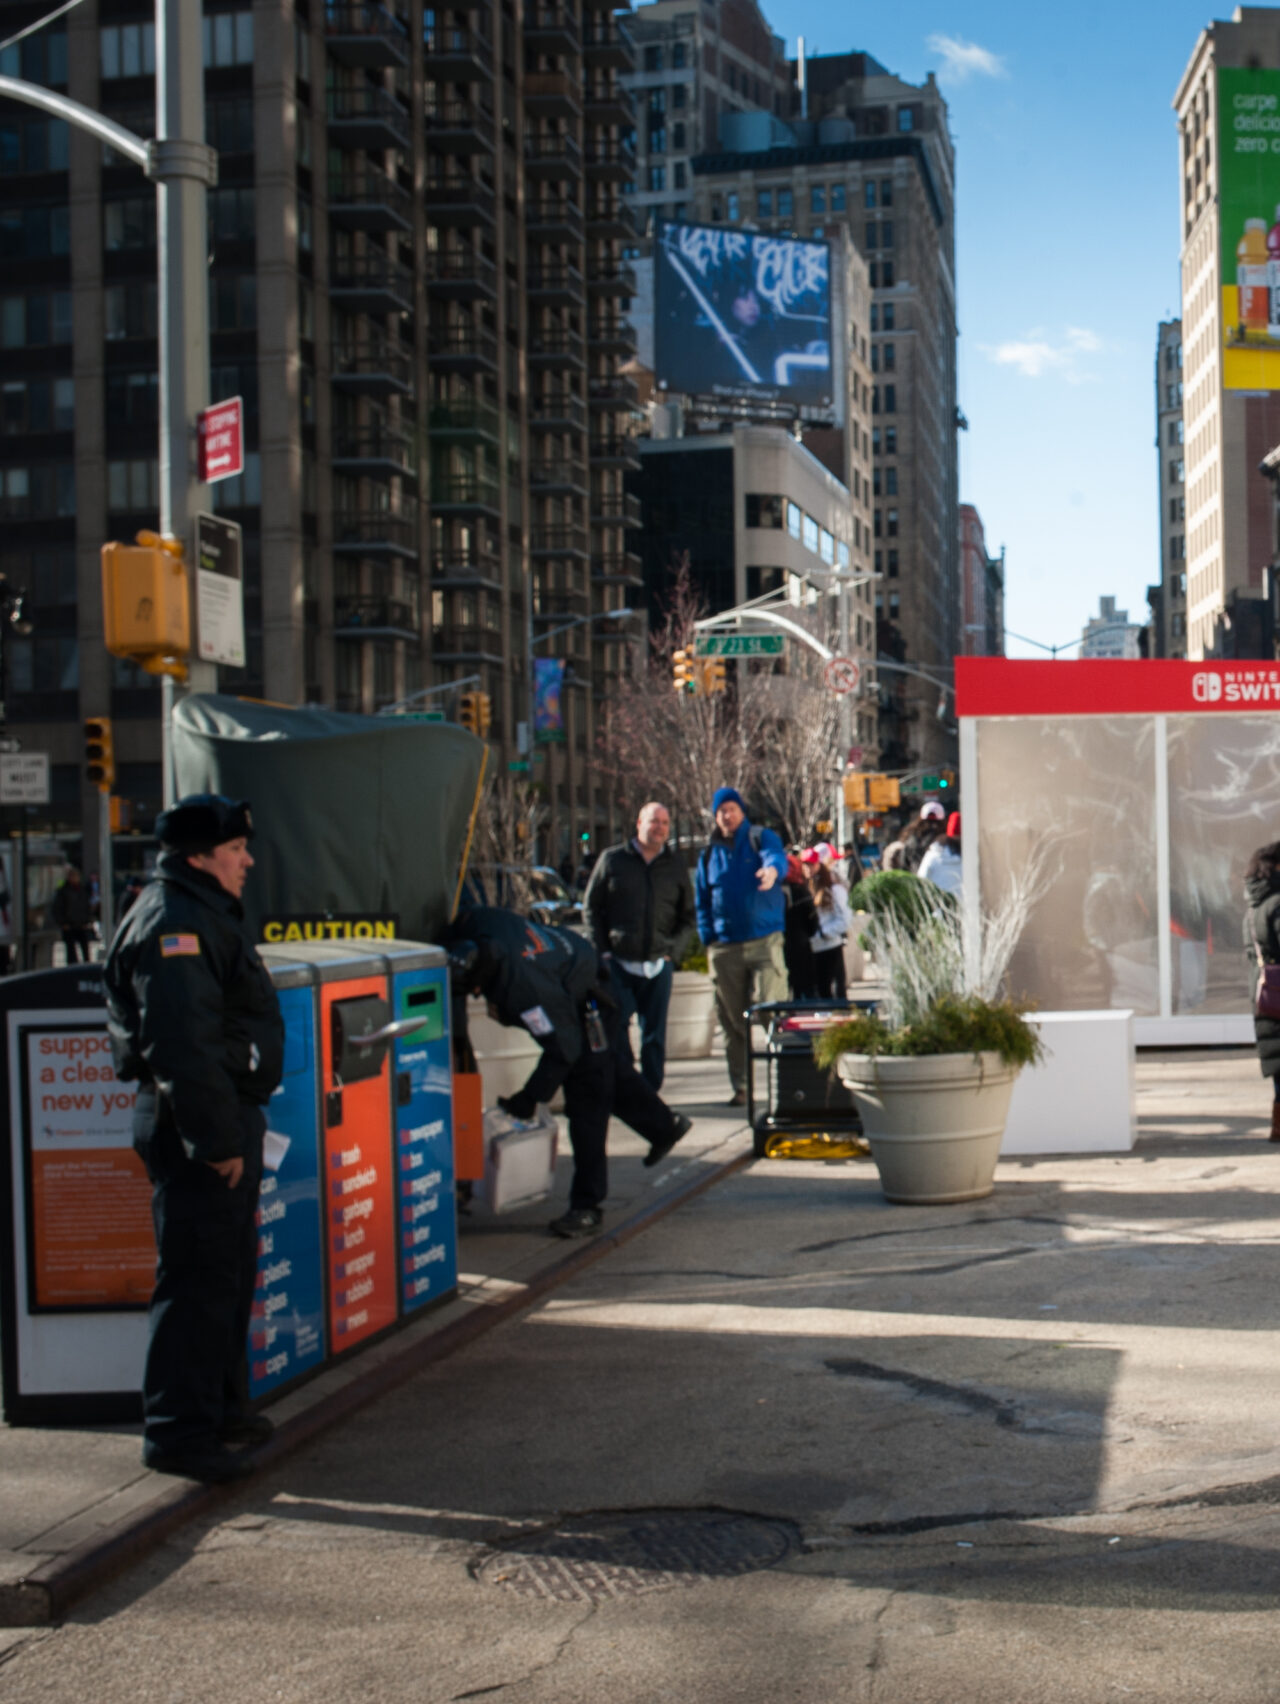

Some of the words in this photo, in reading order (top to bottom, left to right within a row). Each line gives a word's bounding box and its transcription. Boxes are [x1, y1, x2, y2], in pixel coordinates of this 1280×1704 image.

[1234, 137, 1268, 153] zero
[264, 920, 395, 942] CAUTION
[39, 1036, 113, 1060] suppo
[40, 1066, 56, 1083] a
[61, 1062, 115, 1083] clea
[41, 1092, 94, 1111] new
[100, 1091, 137, 1116] yor
